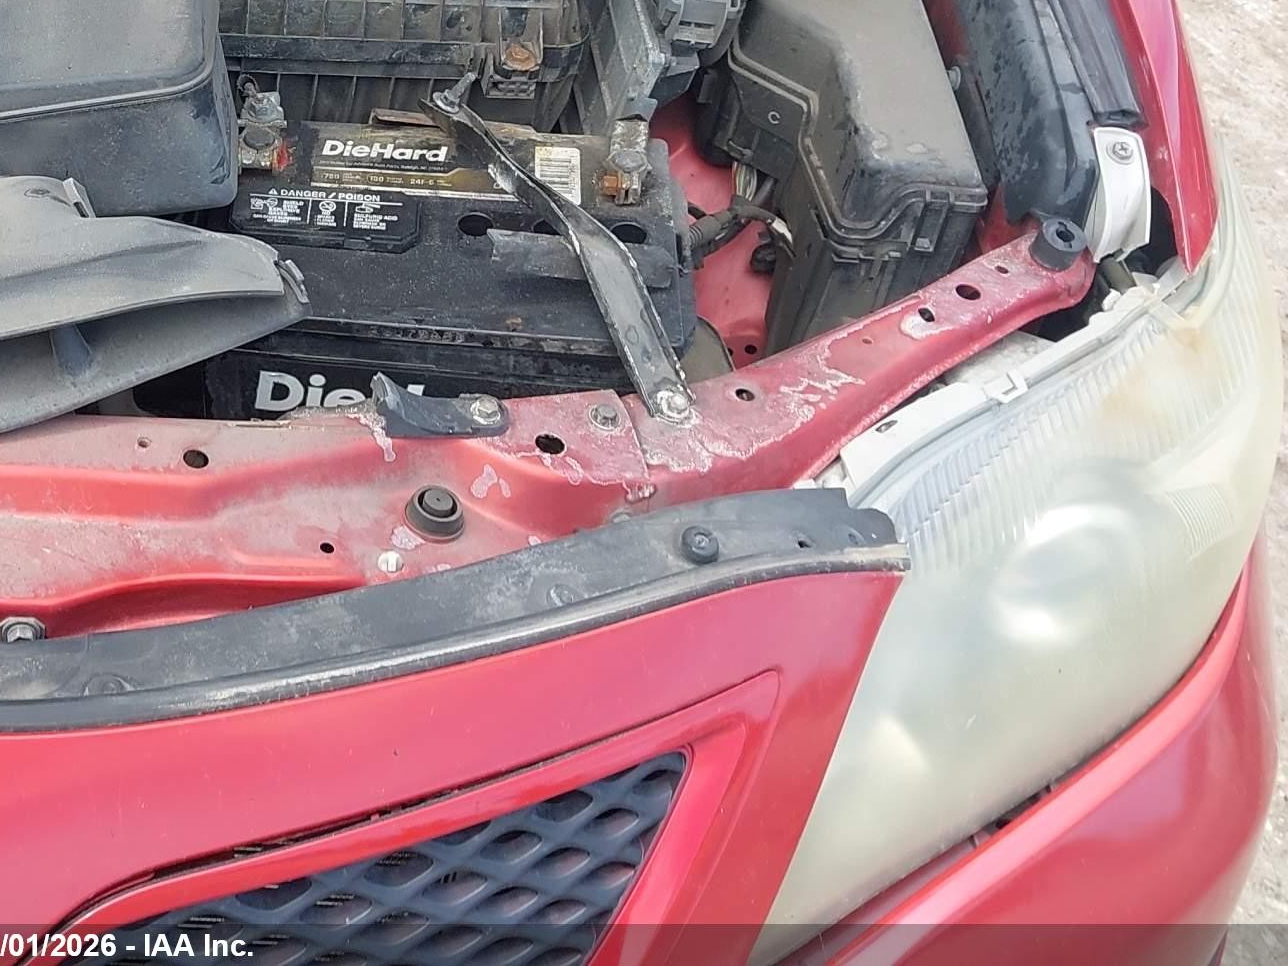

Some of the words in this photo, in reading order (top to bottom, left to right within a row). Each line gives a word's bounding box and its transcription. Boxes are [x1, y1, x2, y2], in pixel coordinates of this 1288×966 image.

[322, 139, 449, 162] DieHard
[280, 189, 326, 199] DANGER
[338, 193, 381, 202] POISON
